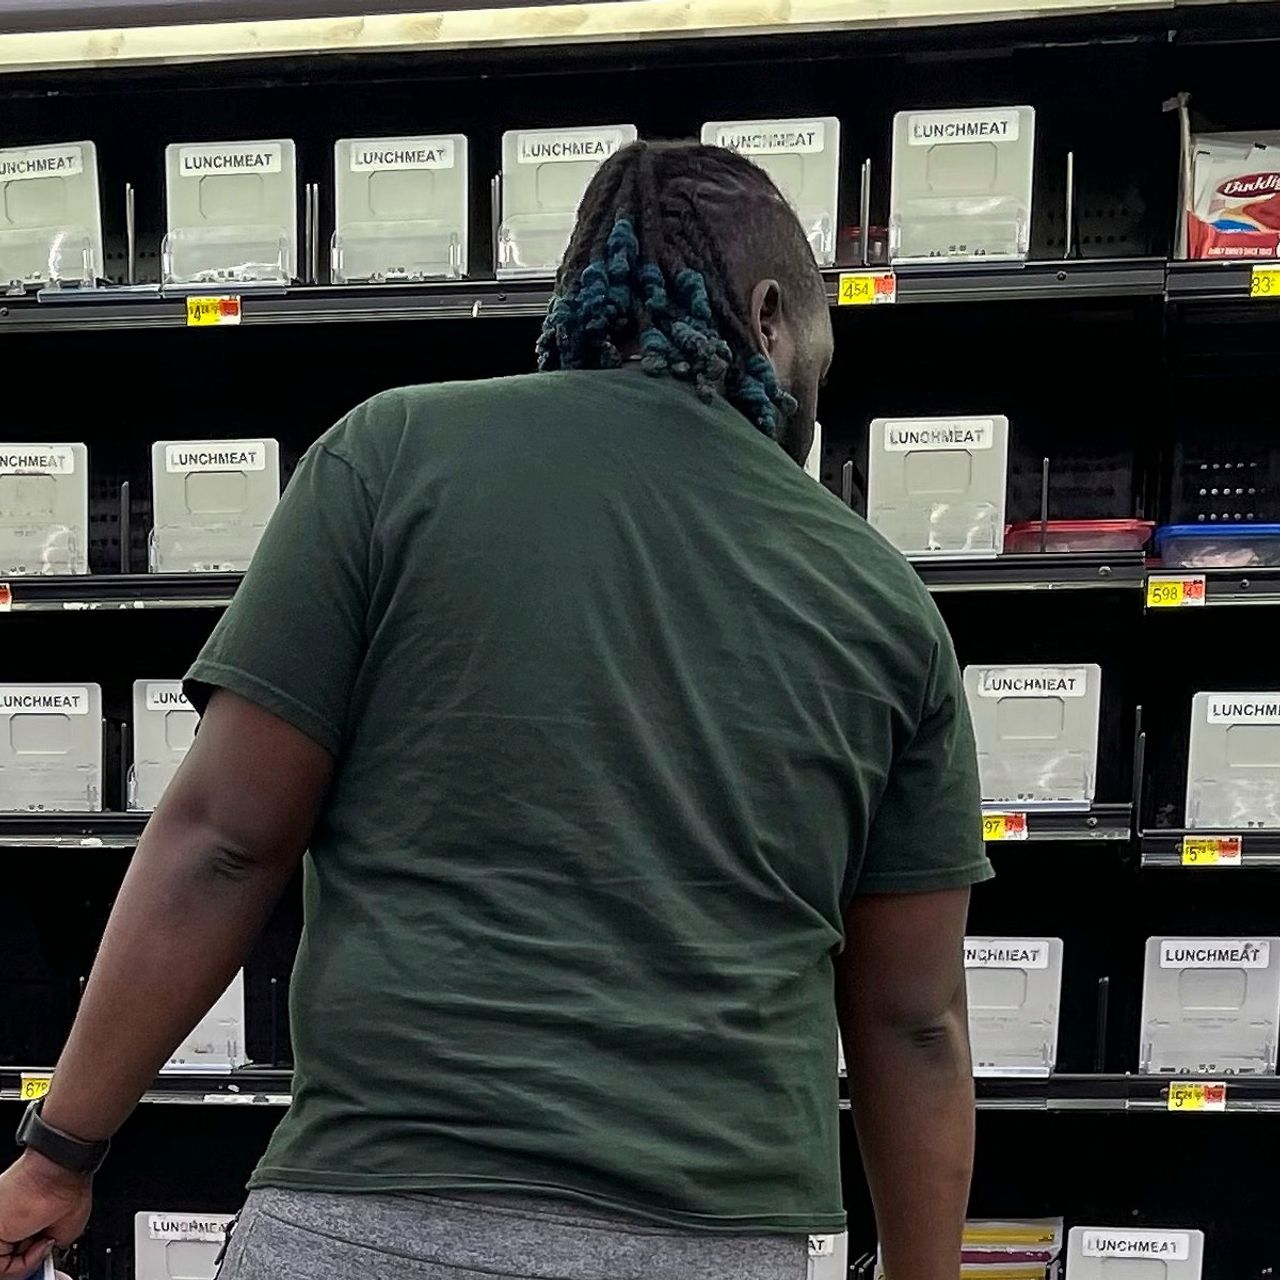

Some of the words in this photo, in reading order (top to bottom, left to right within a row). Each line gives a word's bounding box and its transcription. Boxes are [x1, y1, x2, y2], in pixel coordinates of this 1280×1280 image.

[914, 121, 1008, 137] LUNCHMEAT
[524, 141, 612, 156] LUNCHMEAT
[185, 154, 272, 169] LUNCHMEAT
[356, 149, 445, 164] LUNCHMEAT
[171, 452, 256, 464] LUNCHMEAT
[985, 821, 1000, 833] 97
[964, 949, 1039, 961] NCHMEAT
[1166, 949, 1260, 961] LUNCHMEAT
[153, 1221, 225, 1233] LUNCHMEA
[1087, 1240, 1176, 1253] LUNCHMEAT
